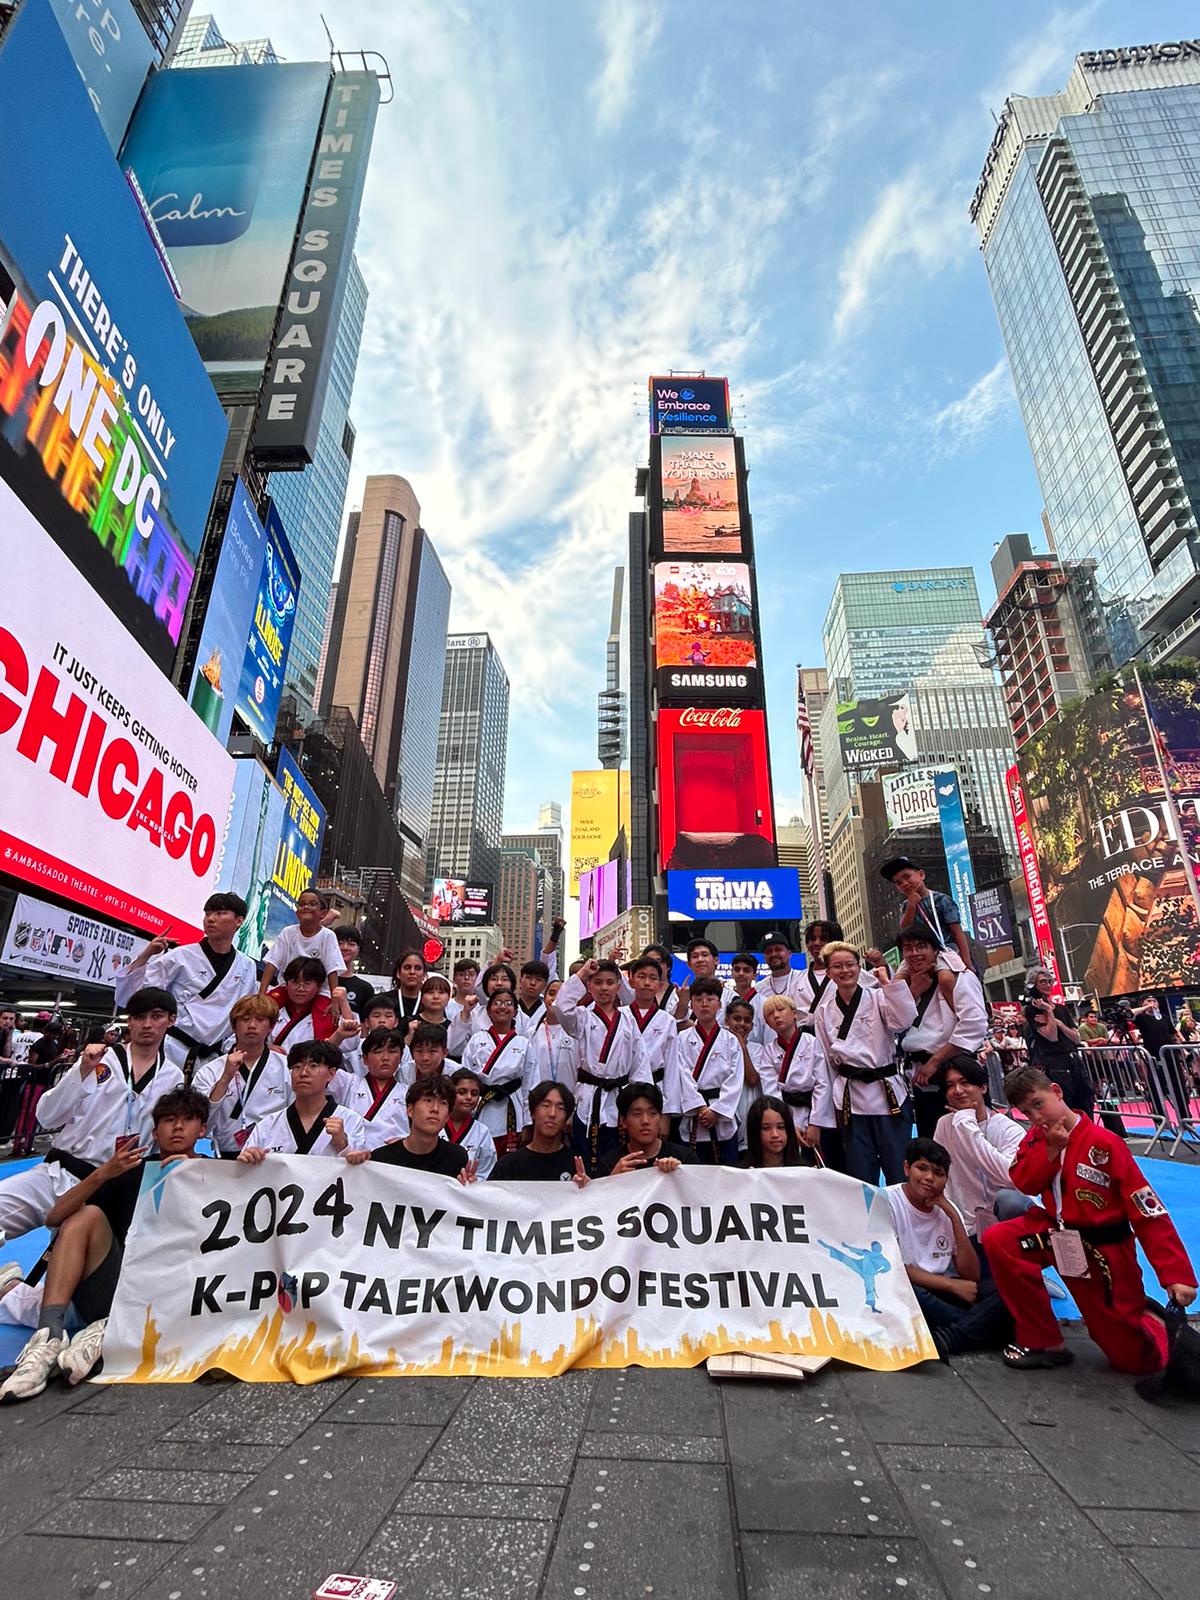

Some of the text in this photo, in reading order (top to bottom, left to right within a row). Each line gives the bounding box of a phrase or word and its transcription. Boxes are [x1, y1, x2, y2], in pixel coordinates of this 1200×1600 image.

[311, 84, 359, 207] TIMES
[149, 193, 246, 222] Calm
[266, 230, 330, 421] SQUARE
[59, 233, 176, 459] THERE'S ONLY
[657, 389, 678, 399] We
[658, 401, 711, 410] Embrace
[25, 300, 161, 538] ONE DC
[658, 412, 717, 422] Resilience
[681, 451, 715, 460] MAKE
[908, 579, 968, 592] BARCLAYS
[671, 674, 747, 687] SAMSUNG
[53, 642, 198, 793] IT JUST KEEPS GETTING HOTTER
[846, 731, 890, 744] Brains. Heart.
[854, 739, 883, 749] Courage.
[891, 771, 925, 793] LITTLE
[135, 809, 148, 824] THE
[12, 851, 69, 883] AMBASSADOR
[71, 877, 99, 898] THEATRE
[1088, 875, 1106, 890] THE
[1105, 856, 1165, 882] TERRACE
[695, 881, 773, 898] TRIVIA
[1024, 851, 1048, 928] CHOCOLATE
[695, 897, 774, 911] MOMENTS
[67, 915, 134, 951] SPORTS FAN SHOP
[977, 915, 1007, 940] SIX
[200, 1177, 810, 1255] 2024 NY TIMES SQUARE
[340, 1265, 631, 1316] TAEKWONDO
[638, 1269, 839, 1309] FESTIVAL
